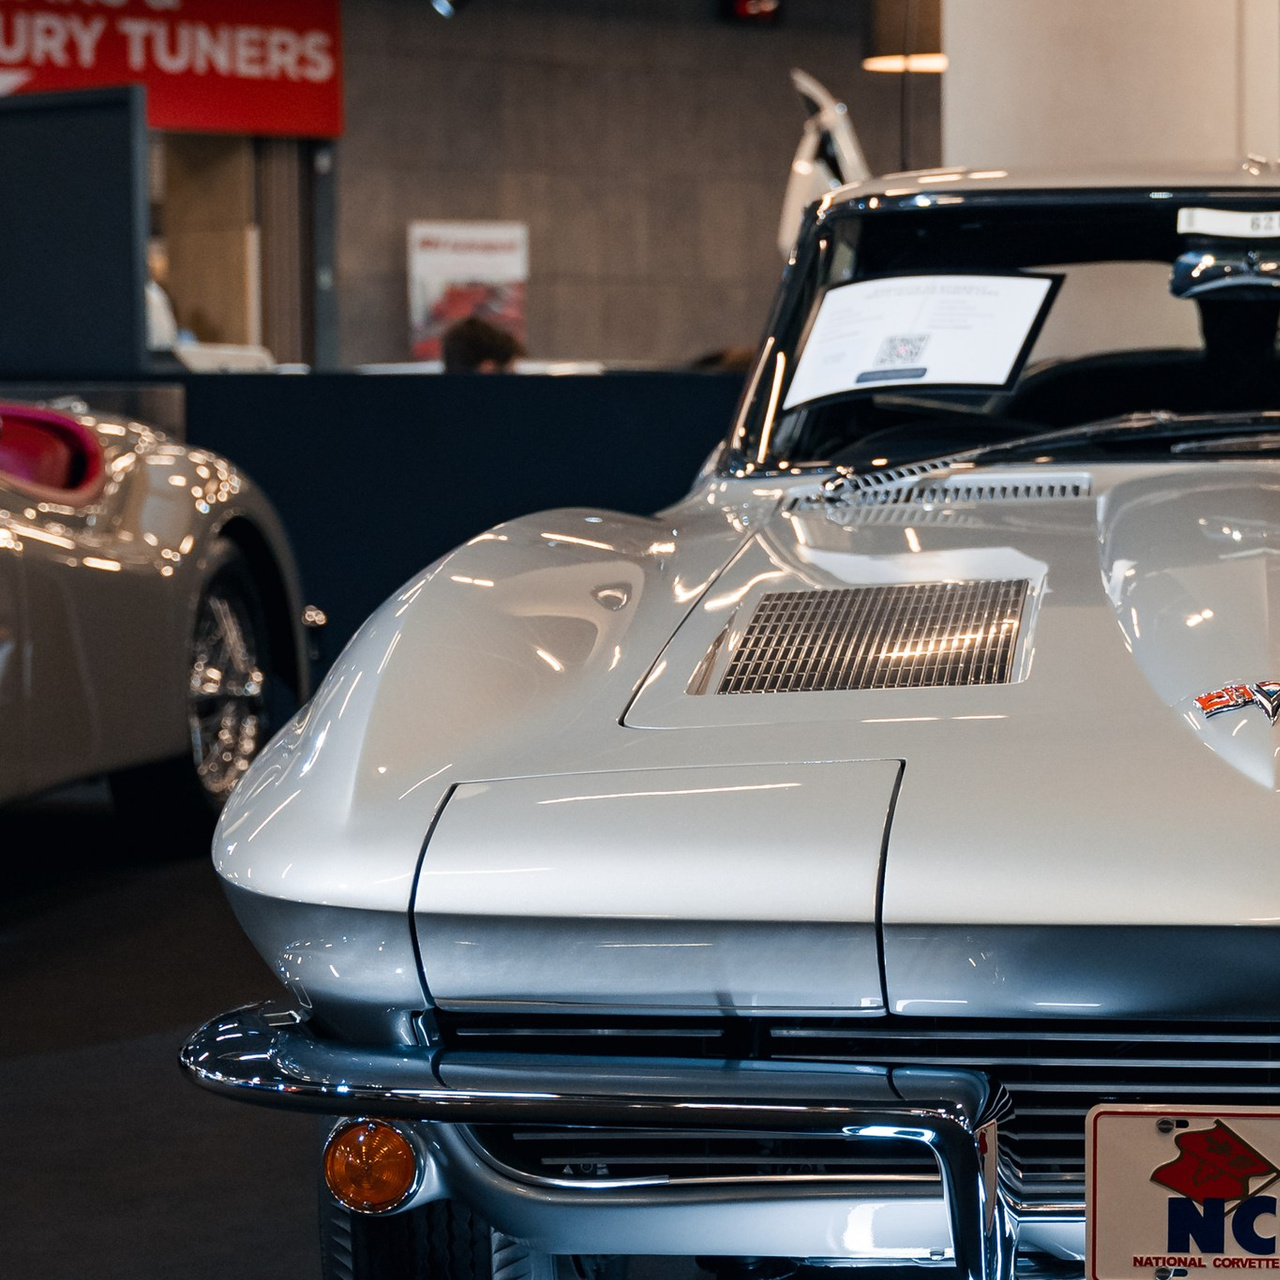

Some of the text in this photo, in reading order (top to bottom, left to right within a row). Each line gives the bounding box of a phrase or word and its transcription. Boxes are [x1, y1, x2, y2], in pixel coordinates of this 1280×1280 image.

[117, 17, 335, 83] TUNERS
[1133, 1256, 1207, 1269] NATIONAL
[1212, 1257, 1280, 1269] CORVETTE
